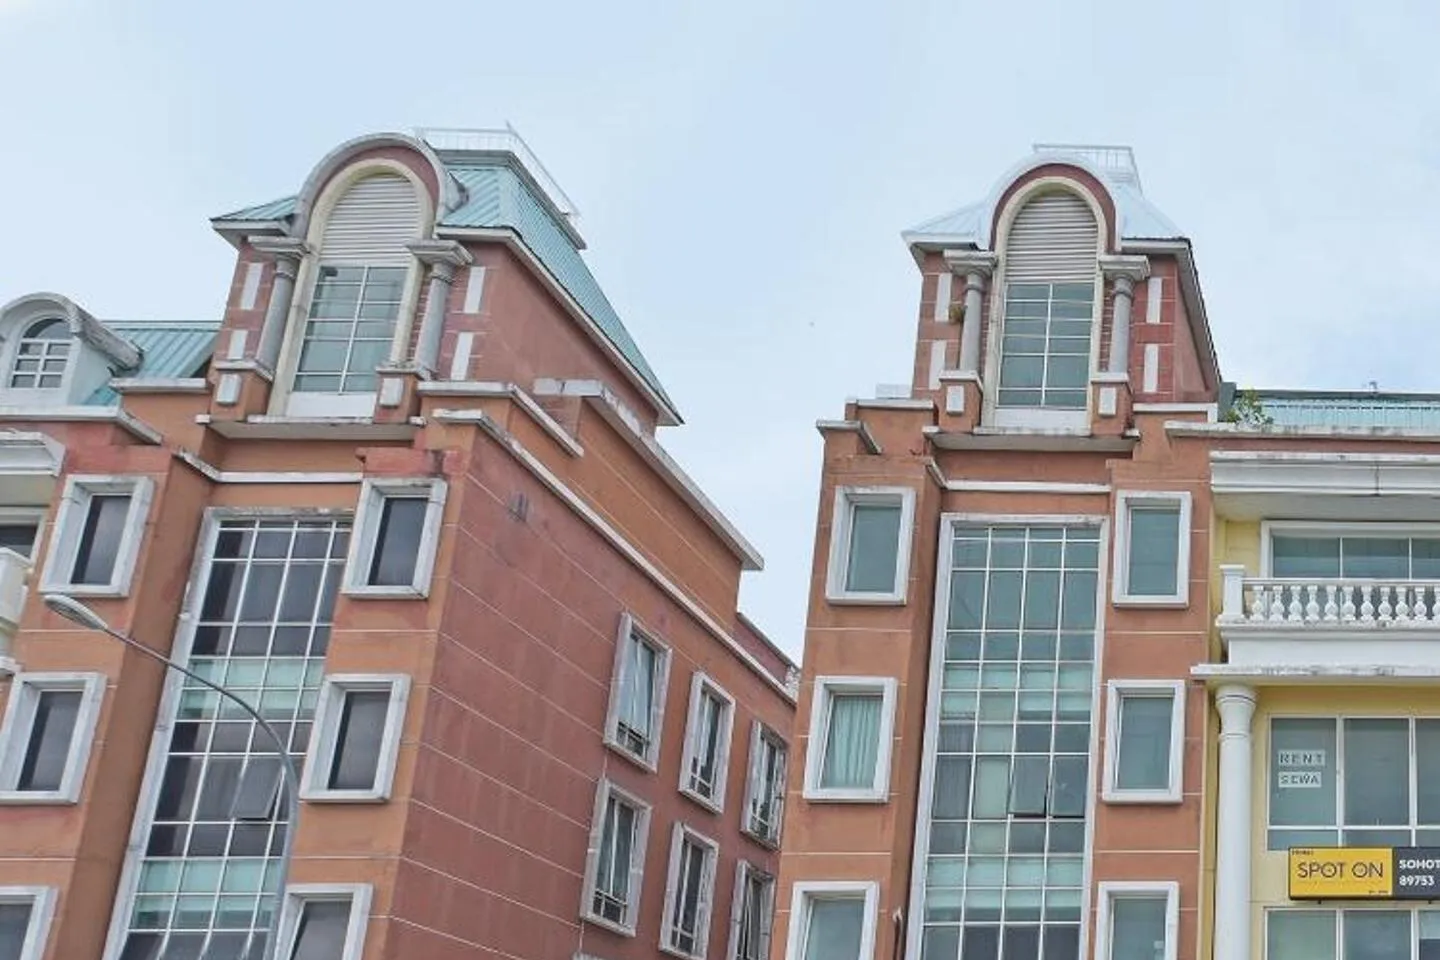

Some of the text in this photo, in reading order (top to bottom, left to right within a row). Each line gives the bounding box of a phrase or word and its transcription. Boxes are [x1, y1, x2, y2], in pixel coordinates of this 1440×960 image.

[1280, 753, 1323, 764] RENT
[1280, 774, 1319, 784] SEWA
[1297, 861, 1384, 879] SPOT ON
[1399, 874, 1435, 886] 89753
